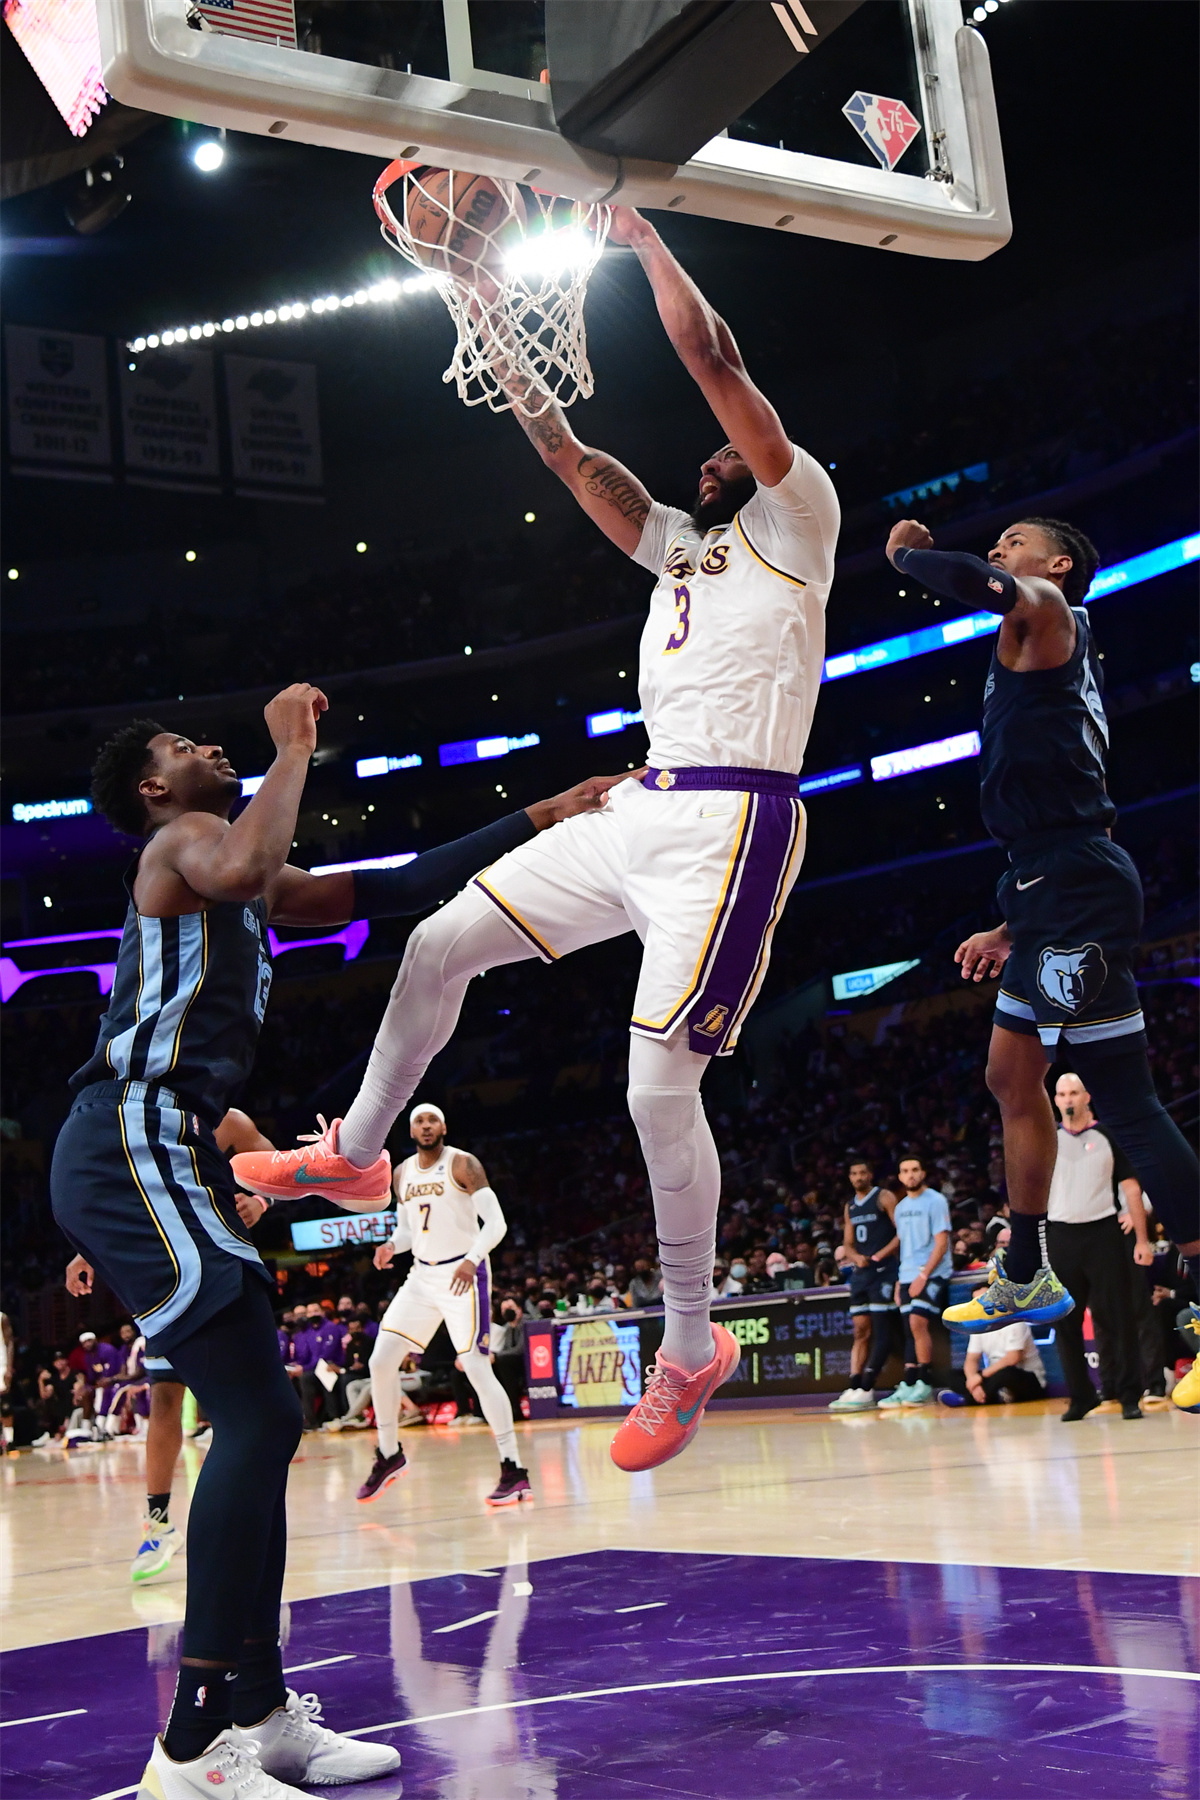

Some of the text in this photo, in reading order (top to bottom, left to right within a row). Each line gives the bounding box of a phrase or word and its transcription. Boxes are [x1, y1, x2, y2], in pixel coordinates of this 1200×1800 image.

[887, 109, 905, 133] 75
[661, 582, 692, 656] 3
[12, 798, 88, 823] Spectrum
[404, 1181, 445, 1202] LAKERS
[320, 1213, 396, 1245] STAPLE
[419, 1203, 431, 1235] 7
[856, 1224, 868, 1243] 0
[794, 1310, 855, 1340] SPURS
[562, 1341, 640, 1397] LAKERS
